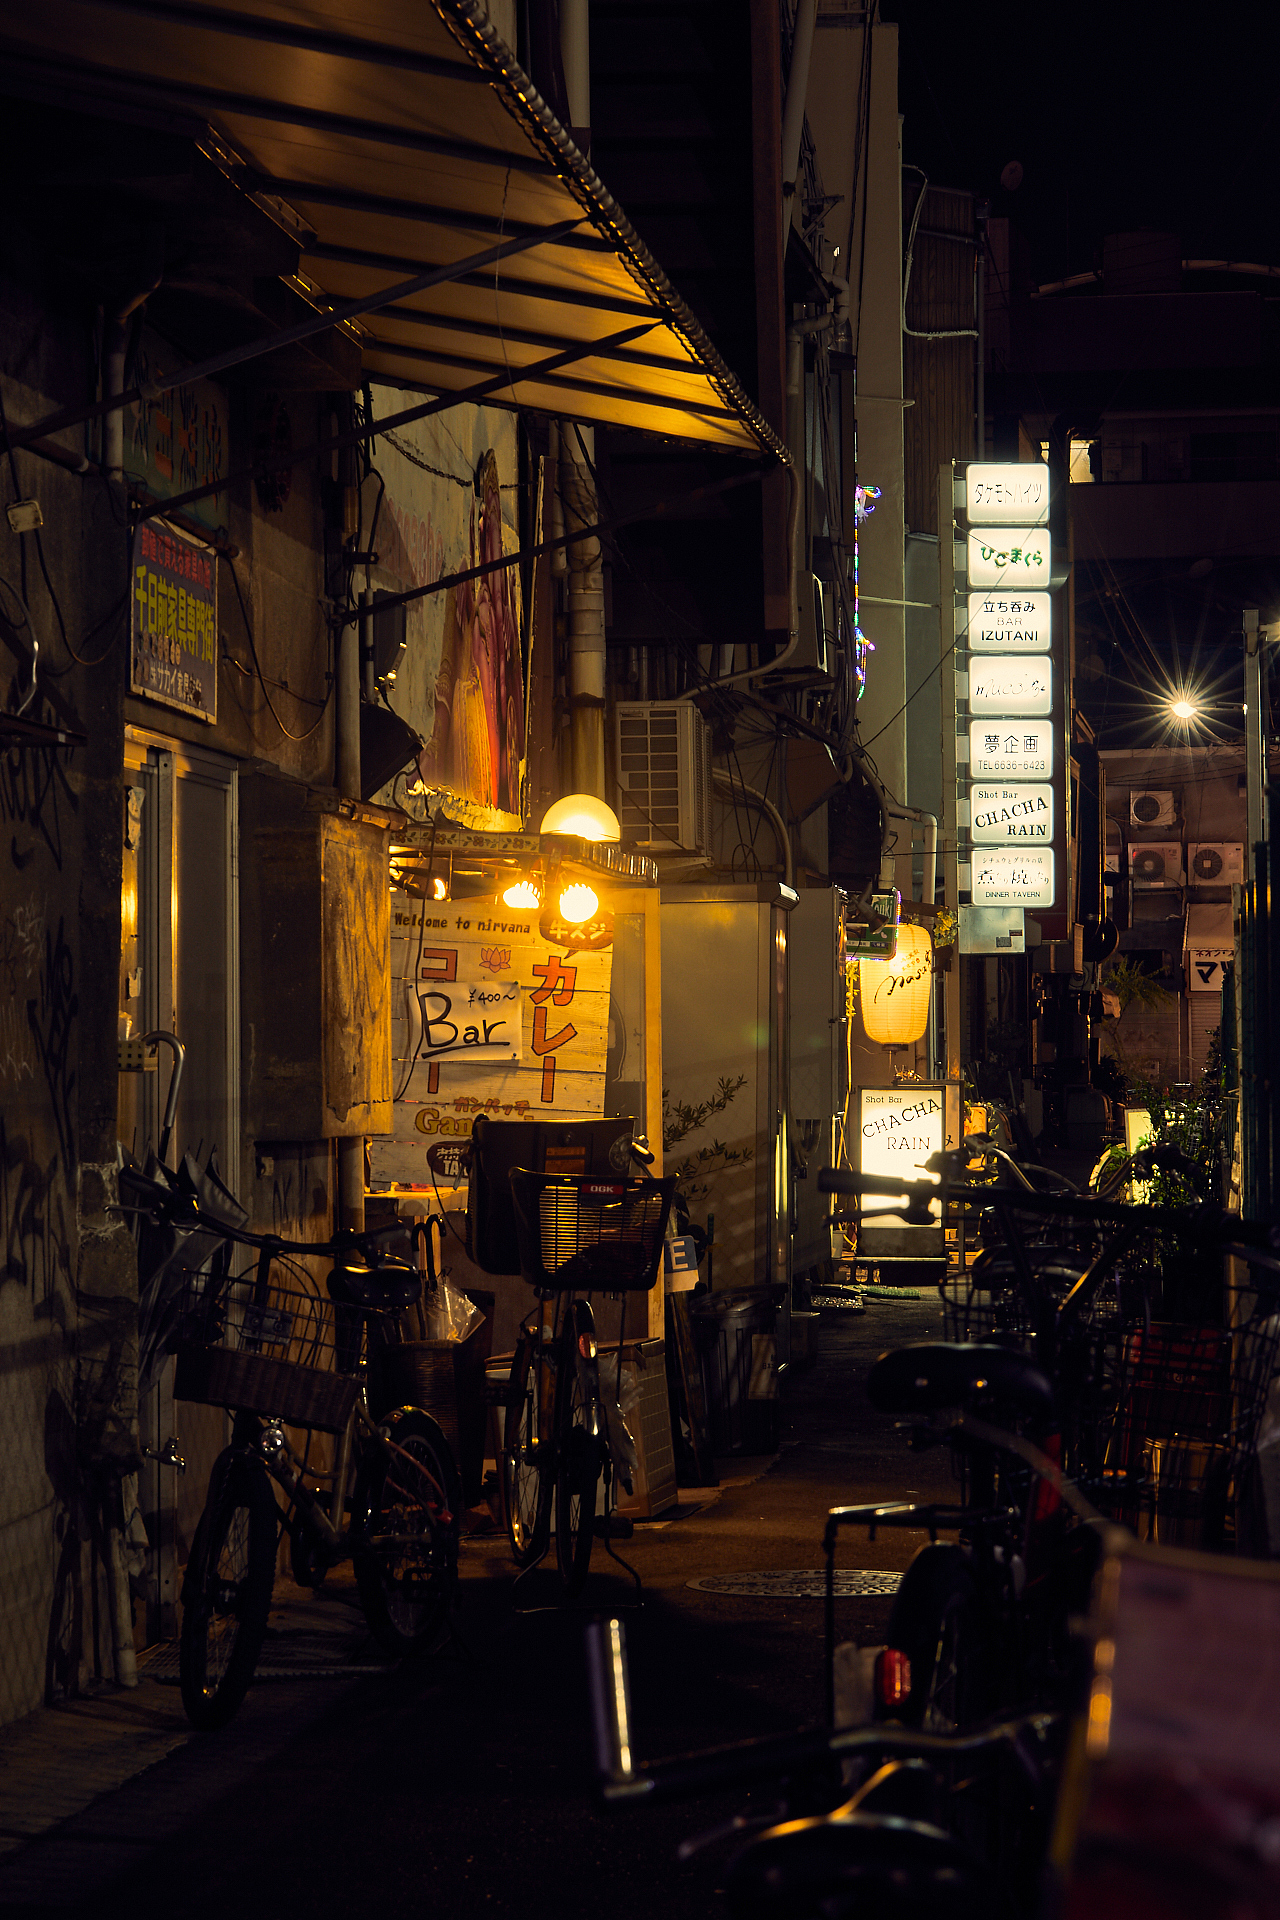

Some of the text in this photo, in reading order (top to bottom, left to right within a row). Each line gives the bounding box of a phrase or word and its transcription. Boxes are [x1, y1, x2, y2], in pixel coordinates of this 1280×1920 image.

[983, 600, 1036, 614] 立ち呑み
[135, 564, 215, 666] 千日前家具専門街
[996, 616, 1024, 627] BAR
[980, 629, 1039, 642] IZUTANI
[983, 733, 1040, 755] 夢企画
[977, 790, 1019, 800] Shot Bar
[974, 795, 1049, 830] CHACHA
[1006, 823, 1048, 837] RAIN
[985, 890, 1042, 899] DINNER TAVERN
[394, 912, 531, 935] Welcome to nirvana
[418, 991, 507, 1048] Bar
[528, 955, 579, 1103] カレー
[865, 1094, 903, 1105] Shot Bar
[861, 1097, 943, 1139] CHACHA
[886, 1136, 932, 1151] RAIN
[589, 1184, 615, 1194] OGK
